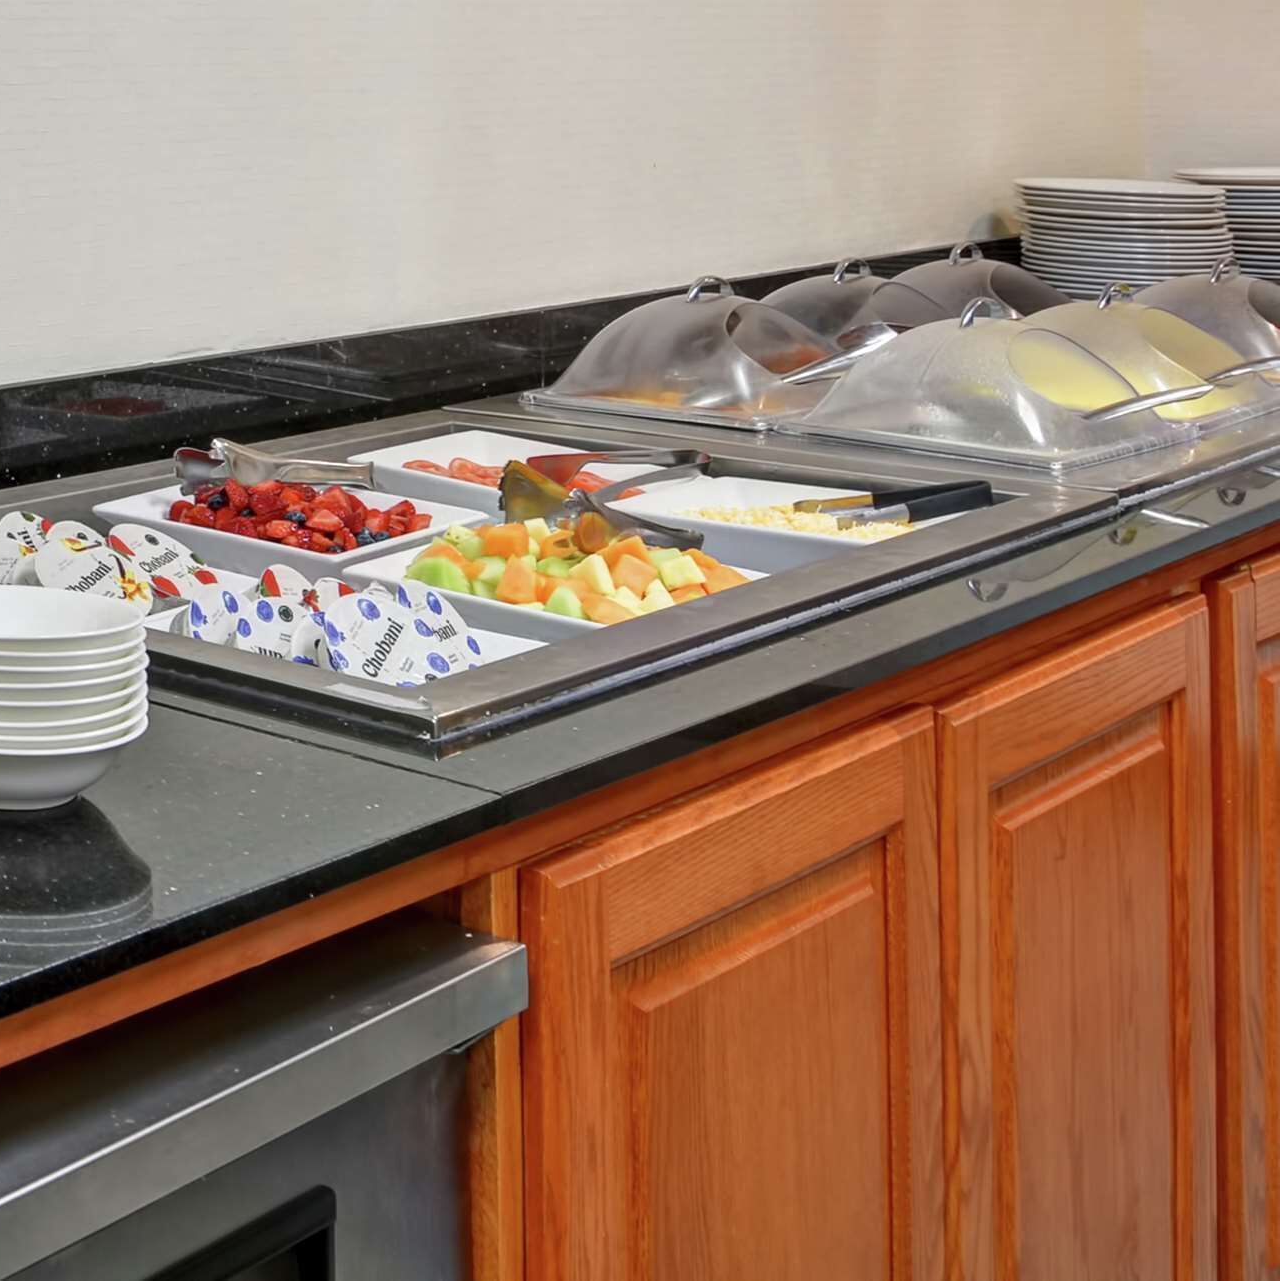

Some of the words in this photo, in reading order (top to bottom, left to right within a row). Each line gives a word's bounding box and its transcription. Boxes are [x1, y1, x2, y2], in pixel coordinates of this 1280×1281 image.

[65, 560, 114, 592] hobani
[139, 546, 180, 574] Chobani
[361, 617, 404, 678] Chobani
